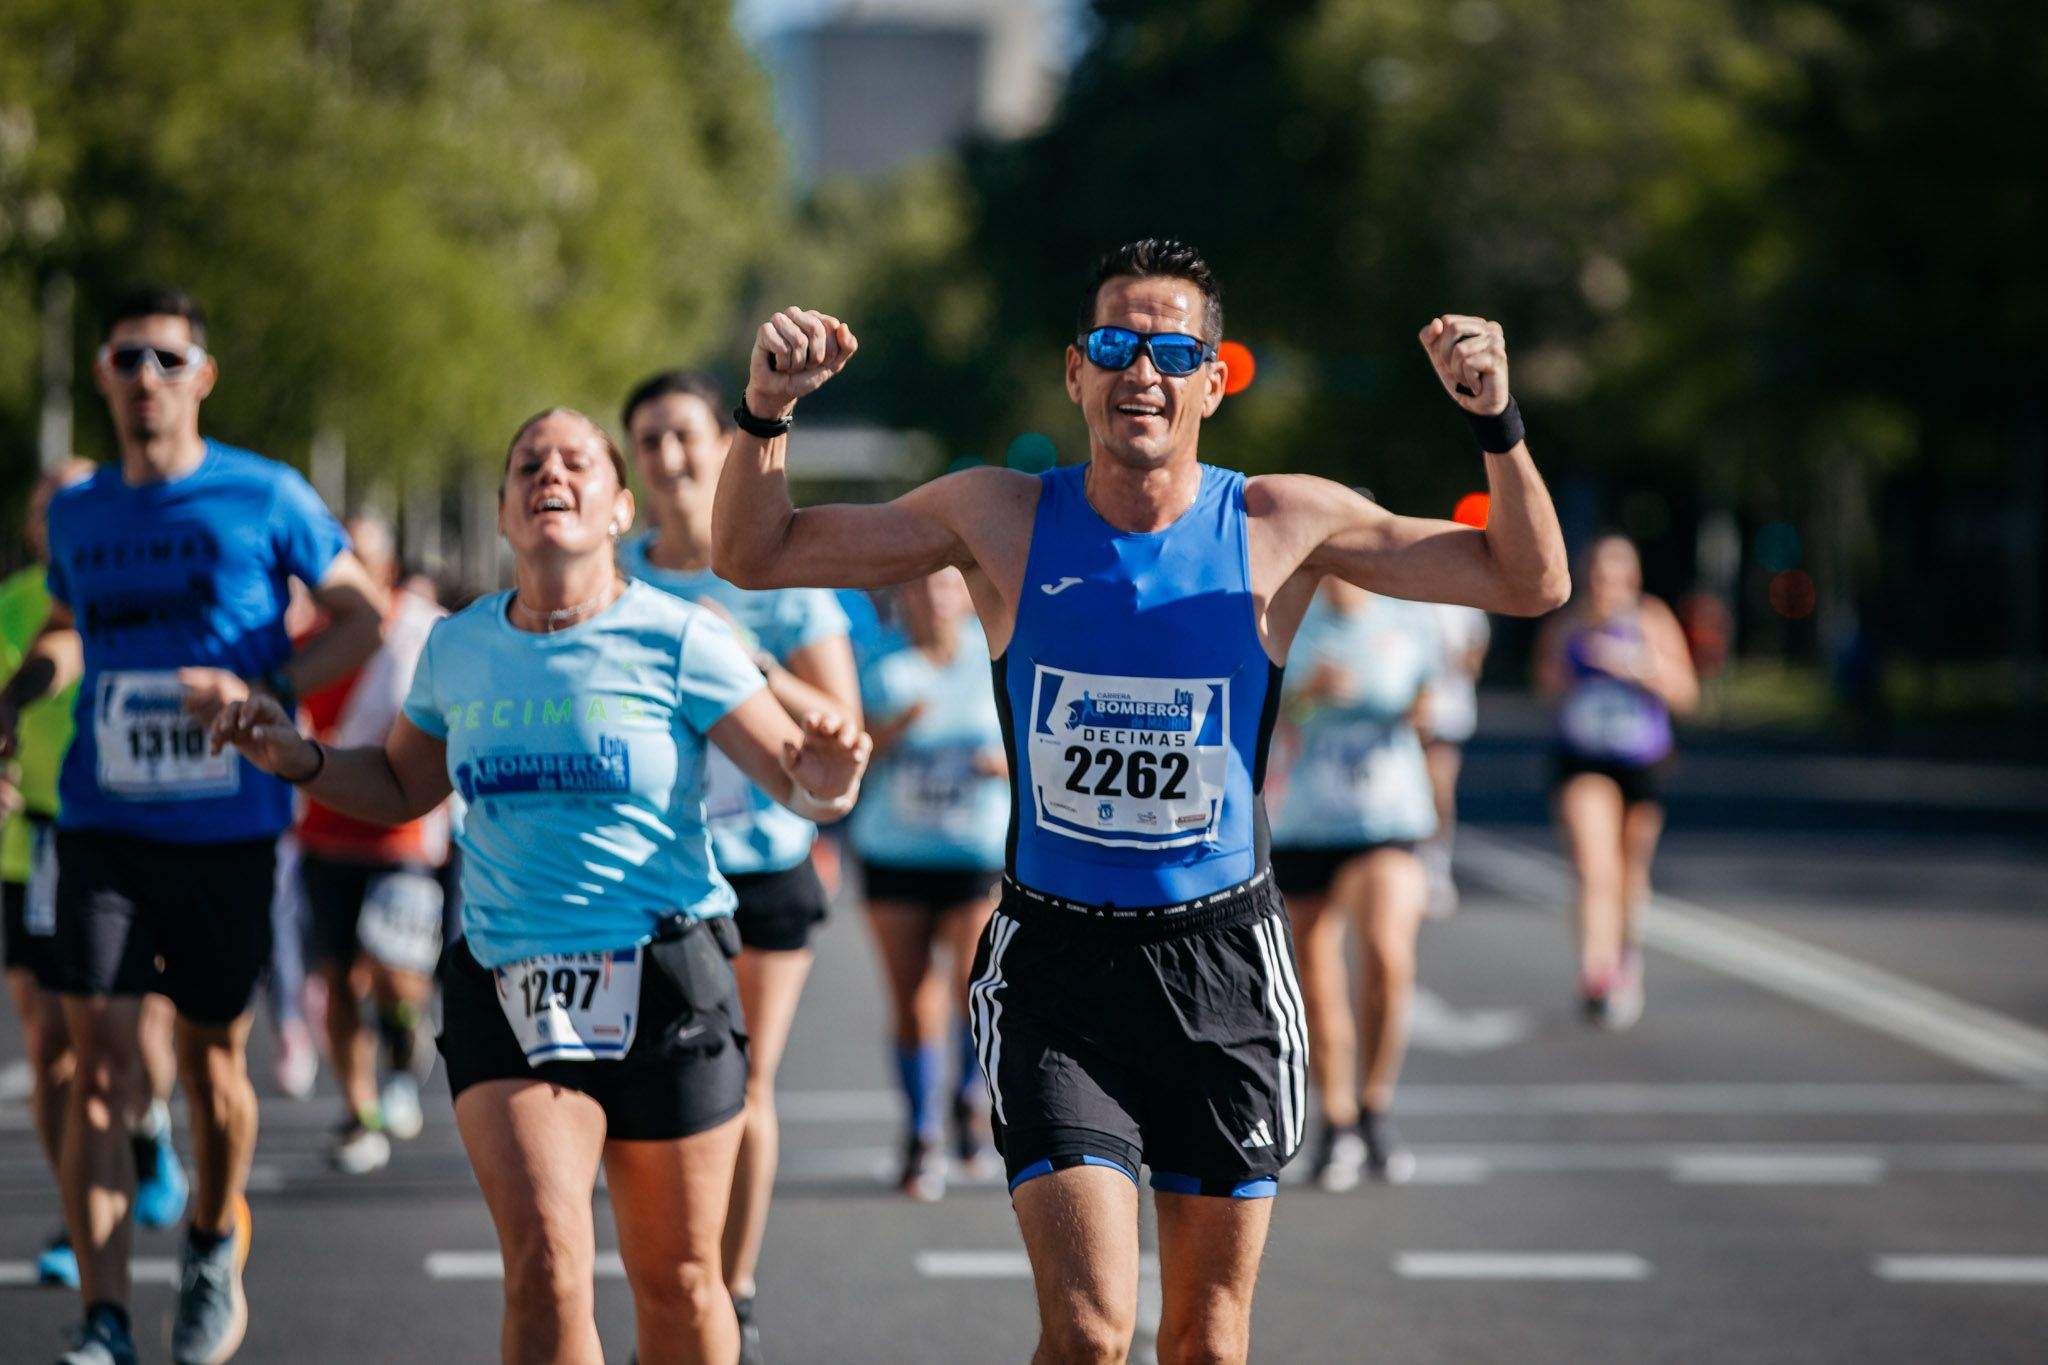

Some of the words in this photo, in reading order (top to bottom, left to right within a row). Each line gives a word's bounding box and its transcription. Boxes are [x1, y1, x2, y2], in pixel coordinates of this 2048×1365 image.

[1097, 692, 1132, 700] CARRERA
[1096, 701, 1189, 717] BOMBEROS
[1084, 729, 1186, 747] DECIMAS
[1064, 745, 1190, 800] 2262
[519, 968, 600, 1018] 1297
